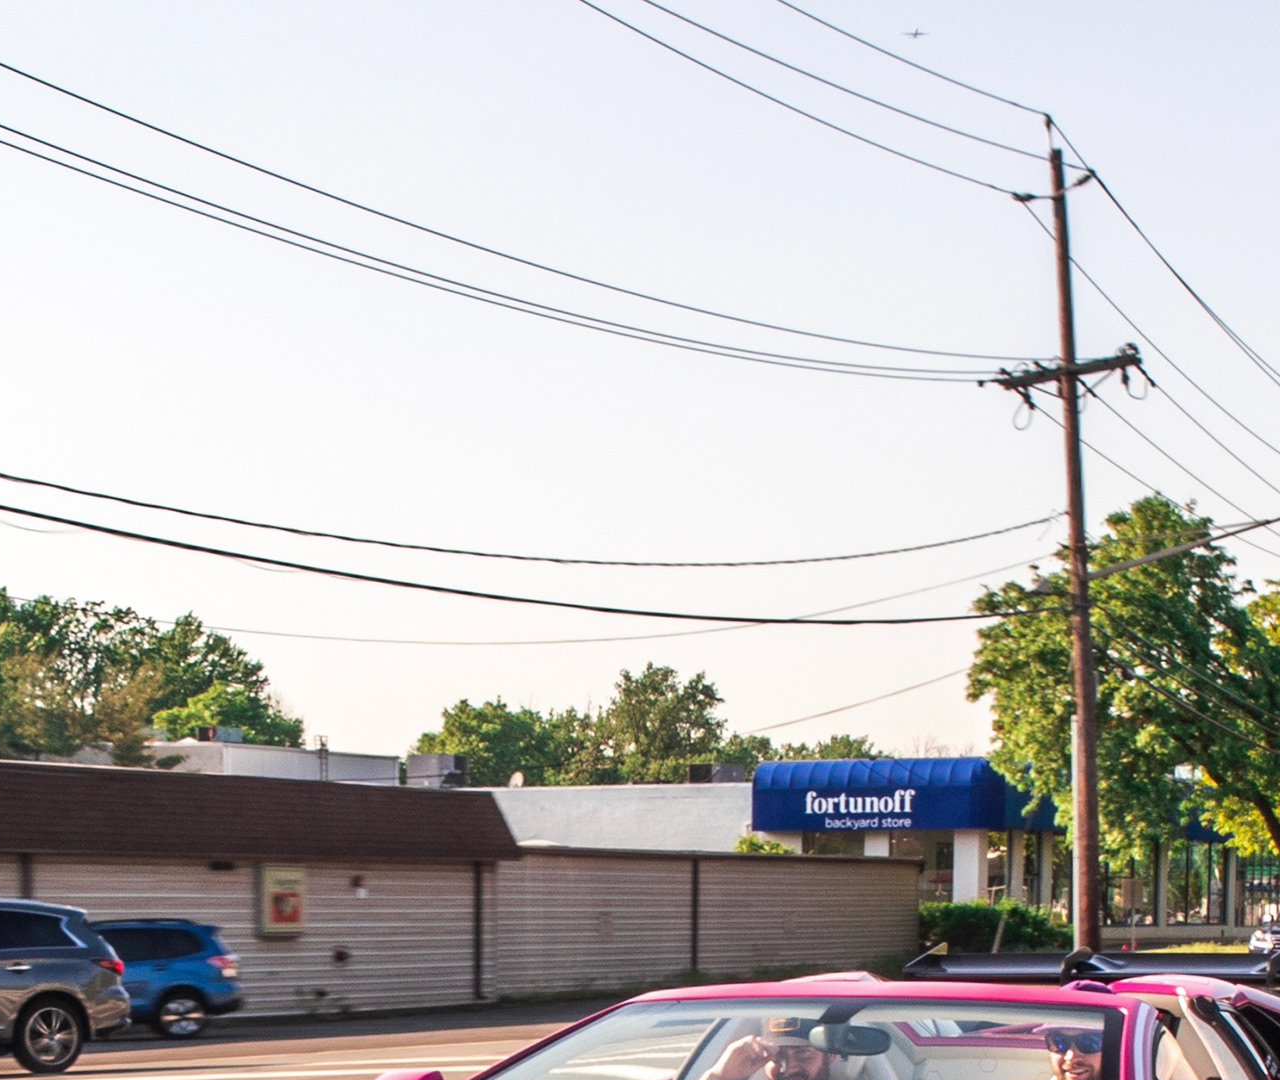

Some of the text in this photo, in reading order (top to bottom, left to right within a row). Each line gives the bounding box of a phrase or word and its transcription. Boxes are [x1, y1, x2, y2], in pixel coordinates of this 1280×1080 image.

[805, 789, 915, 814] fortunoff
[825, 817, 912, 830] backyard store
